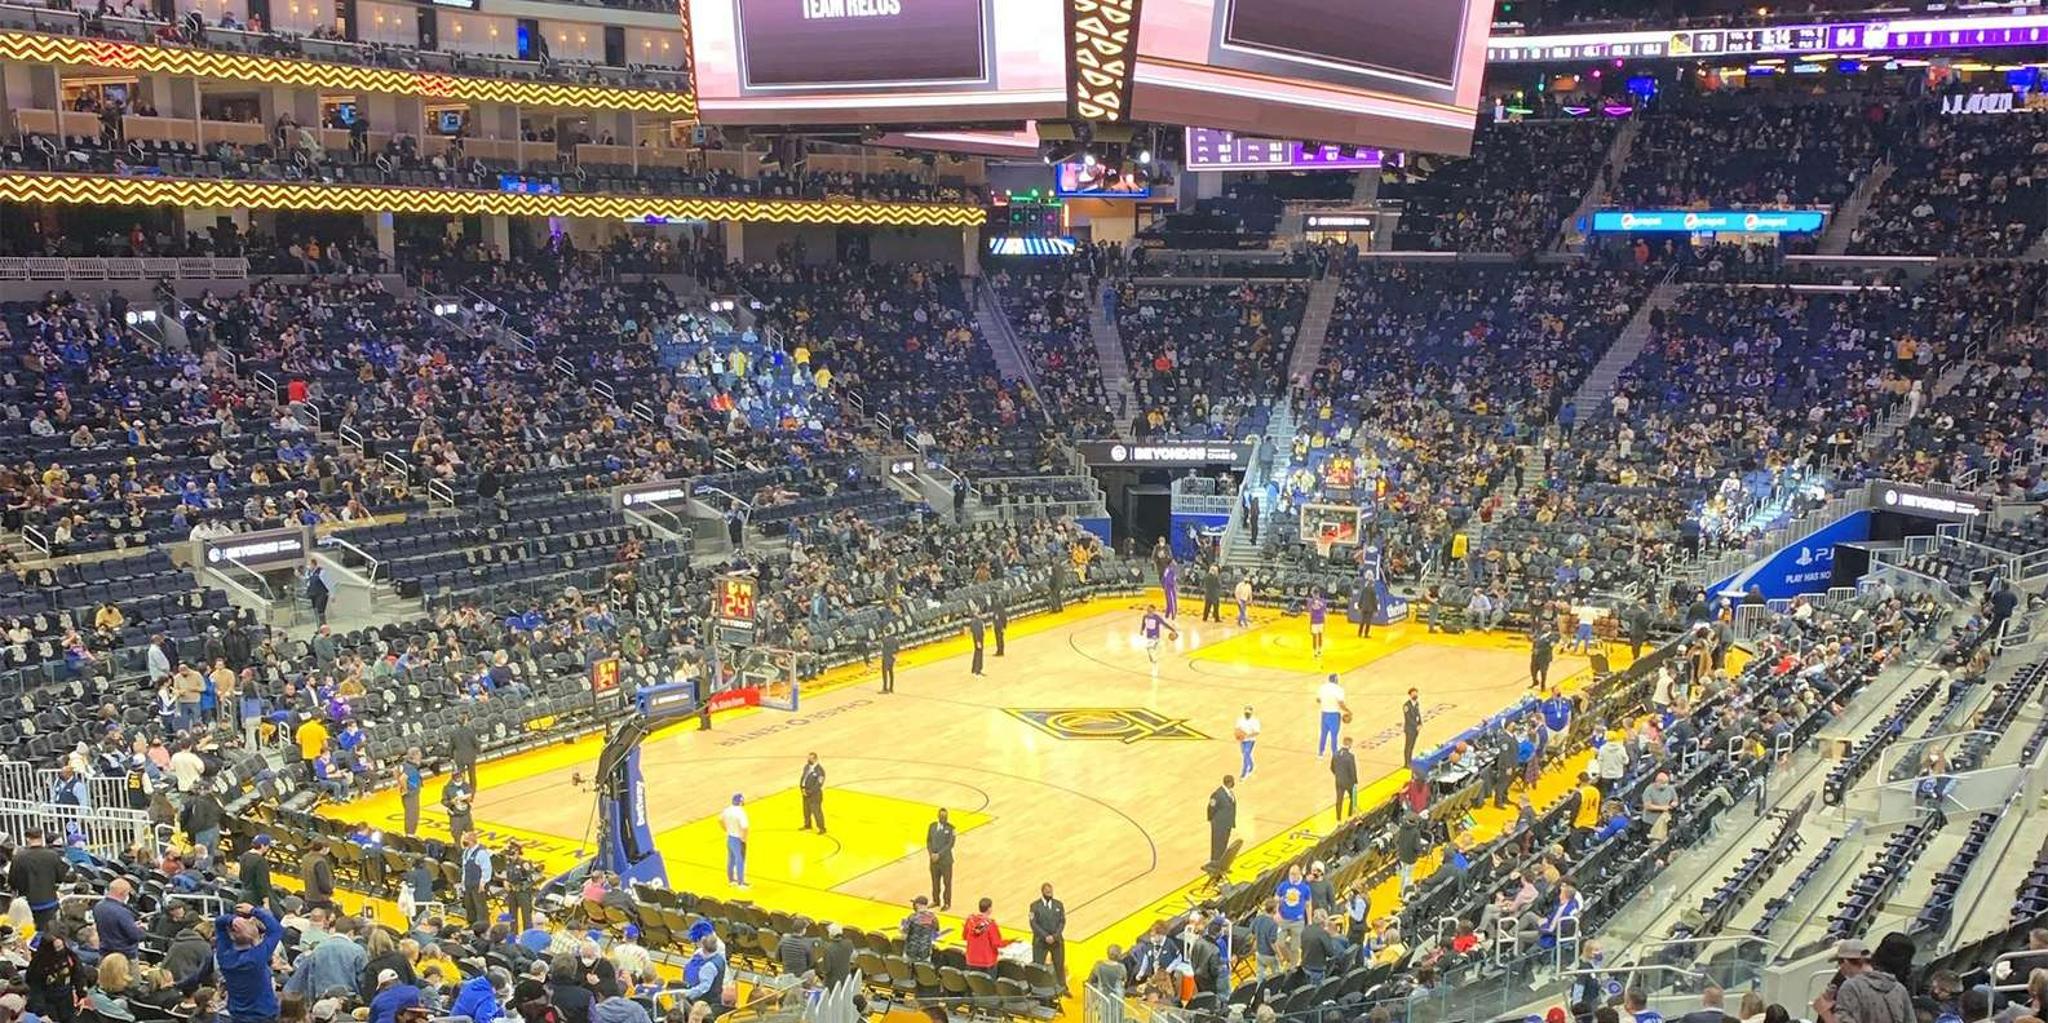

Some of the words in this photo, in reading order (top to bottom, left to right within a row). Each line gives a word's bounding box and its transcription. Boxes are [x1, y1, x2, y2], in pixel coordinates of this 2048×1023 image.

[1785, 573, 1803, 584] PLAY
[1804, 571, 1818, 582] HAS
[725, 594, 749, 616] 24
